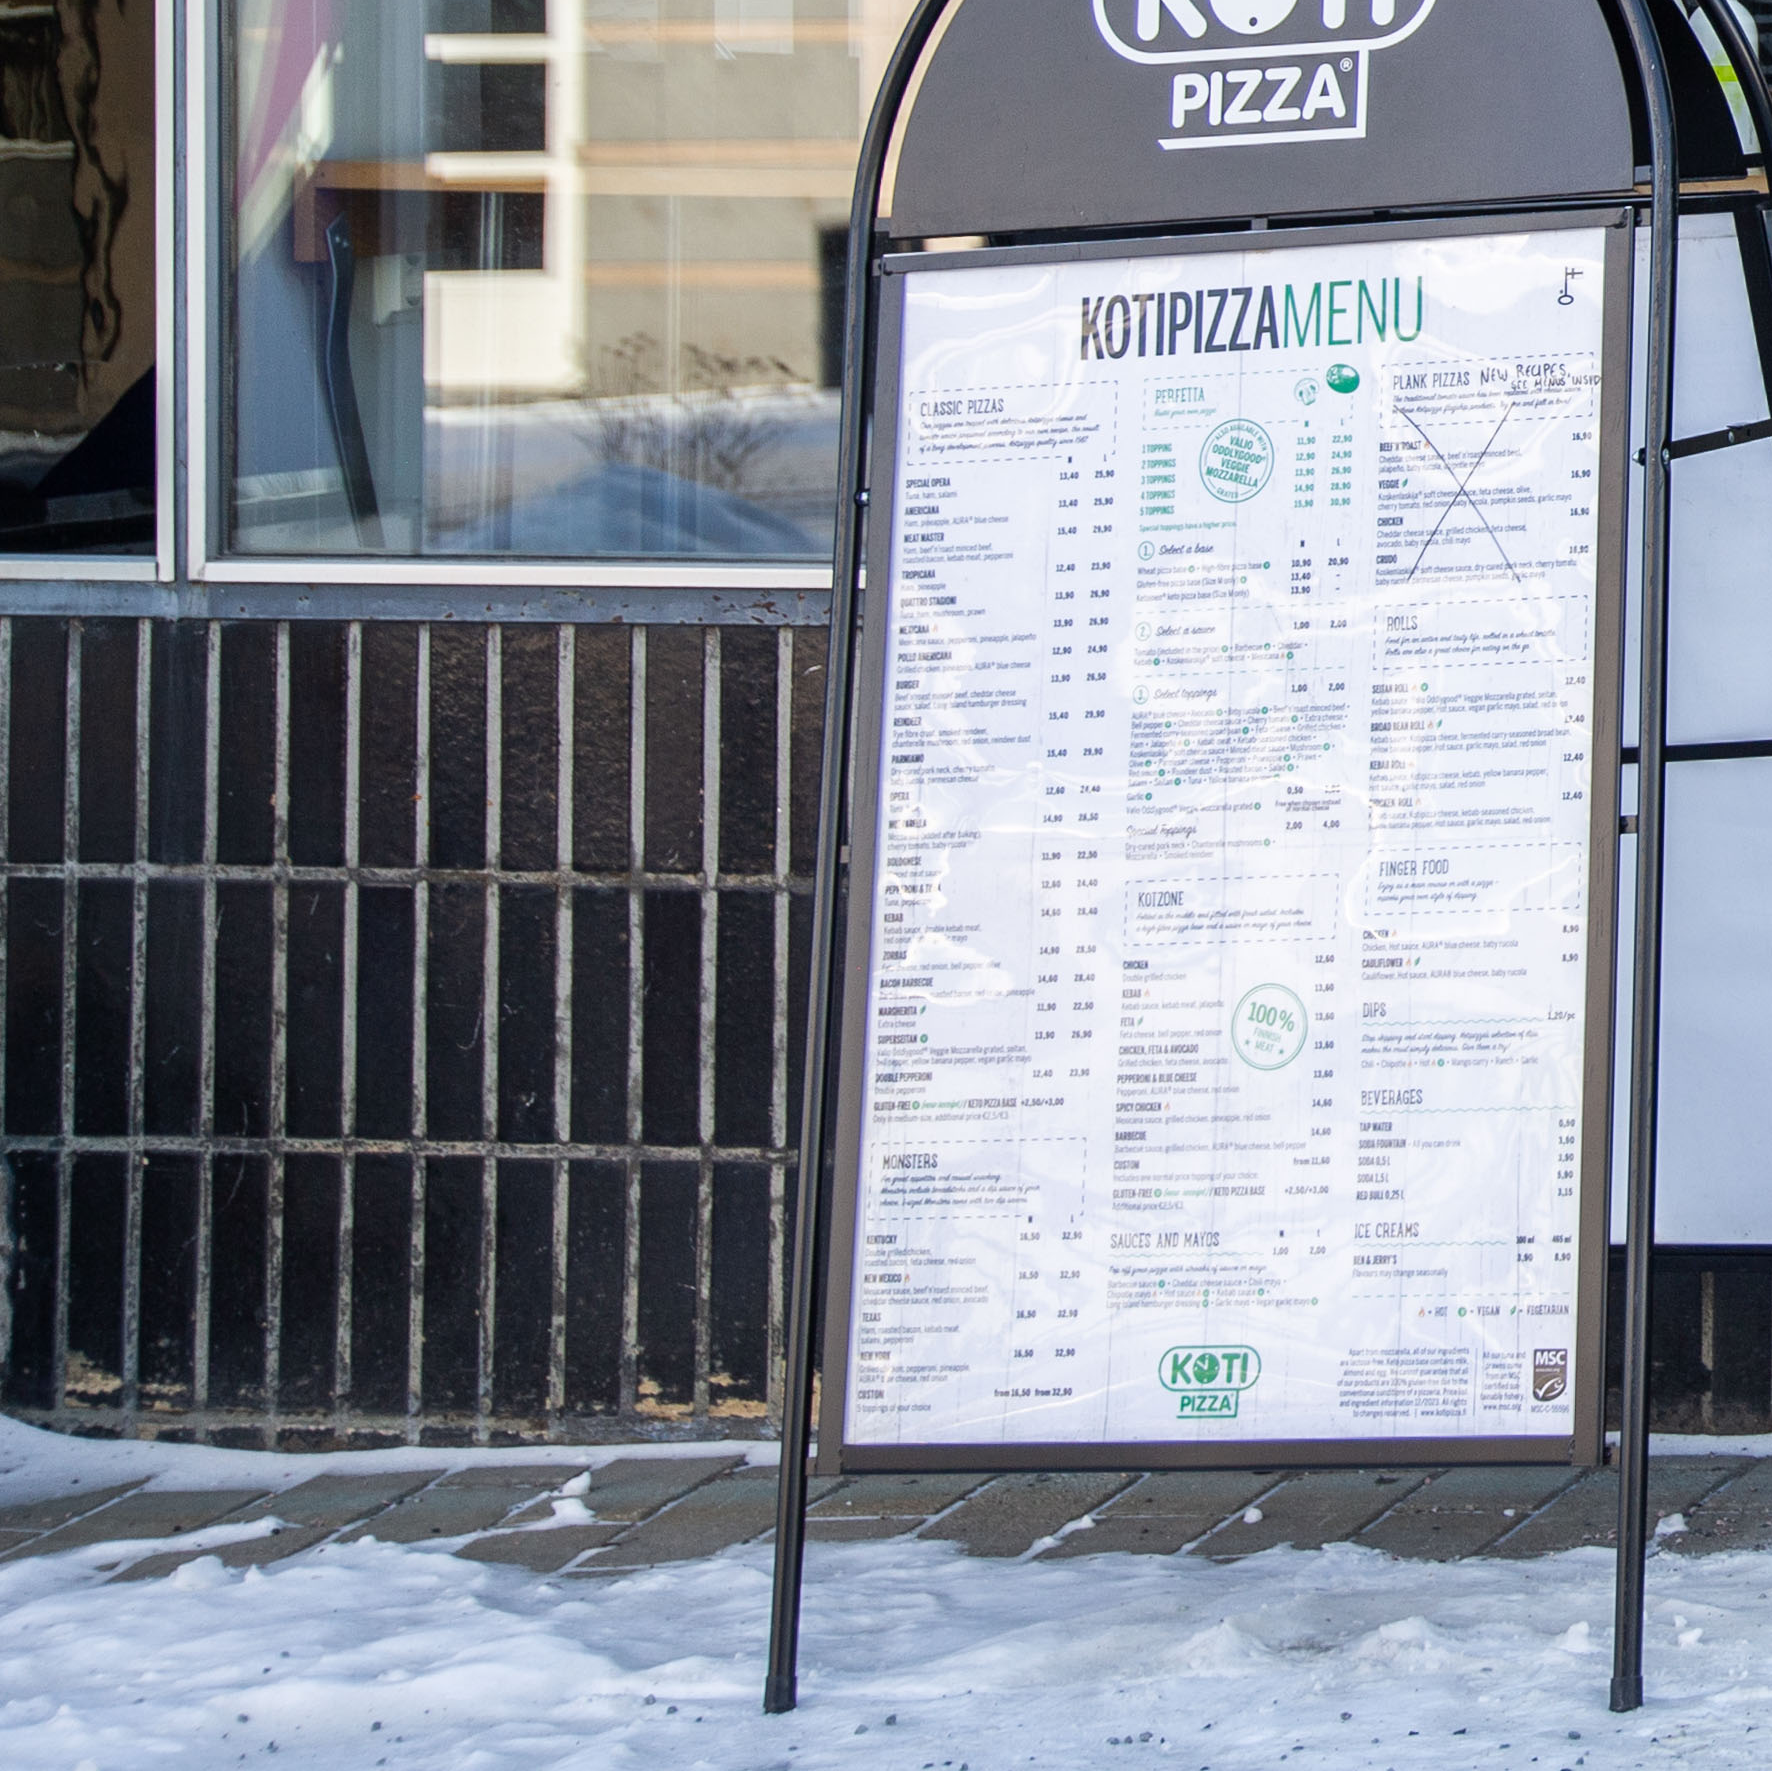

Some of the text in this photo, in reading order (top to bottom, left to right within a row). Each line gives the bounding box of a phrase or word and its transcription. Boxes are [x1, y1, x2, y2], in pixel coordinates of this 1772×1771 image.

[1392, 371, 1470, 391] PLANK PIZZAS
[1480, 366, 1509, 386] NEW
[1511, 379, 1528, 391] SEE
[1154, 386, 1206, 404] PERFETTA
[920, 398, 1005, 417] CLASSIC PIZZAS
[1230, 435, 1254, 450] VALIO
[1296, 436, 1316, 446] 11,90
[1146, 443, 1173, 454] TOPPING
[1295, 452, 1316, 462] 12,90
[1146, 459, 1177, 470] TOPPINGS
[1221, 457, 1251, 474] VEGGIE
[1059, 469, 1115, 481] 13,40 25,90
[1205, 465, 1259, 488] MOZZARELLA
[1294, 467, 1315, 477] 13,90
[905, 477, 951, 489] SPECIAL OPERA
[1146, 474, 1176, 485] TOPPINGS
[1377, 479, 1400, 490] VEGGIE
[1294, 483, 1315, 493] 14,90
[1145, 490, 1176, 501] TOPPINGS
[1058, 497, 1114, 509] 13,40 25,90
[1294, 499, 1314, 509] 15,90
[904, 505, 940, 516] AMERICANA
[1145, 506, 1175, 517] TOPPINGS
[1377, 516, 1404, 527] CHICKEN
[1057, 526, 1077, 536] 15,40
[904, 532, 945, 543] MEAT MASTER
[1158, 542, 1215, 556] Select base
[1376, 554, 1398, 565] CRUDO
[1055, 561, 1111, 573] 12,40 23,90
[901, 569, 936, 580] TROPICANA
[1290, 571, 1311, 581] 13,40
[1054, 590, 1075, 600] 13,90
[928, 596, 957, 606] STAGIONI
[1053, 618, 1074, 628] 13,90
[1293, 621, 1310, 631] 1,00
[1386, 614, 1418, 631] ROLLS
[1155, 625, 1216, 637] Select sauce
[1052, 644, 1108, 656] 12,90 24,90
[1290, 682, 1346, 693] 1,00 2,00
[1153, 687, 1218, 702] Select toppings
[1048, 711, 1069, 721] 15,40
[1370, 720, 1425, 732] BROAD ROLL
[1047, 748, 1068, 758] 15,40
[1563, 752, 1585, 762] 12,40
[1561, 791, 1583, 801] 12,40
[1285, 819, 1341, 831] 2,00 4,00
[1041, 851, 1062, 861] 11,90
[1379, 858, 1449, 877] FINGER FOOD
[1137, 890, 1185, 908] KOTZONE
[884, 912, 904, 923] KEBAB
[1122, 960, 1149, 971] CHICKEN
[1361, 957, 1404, 969] CAULIFLOWER
[879, 977, 934, 989] BACON BARBECUE
[1121, 988, 1142, 999] KEBAB
[1036, 1002, 1057, 1012] 11,90
[1362, 1001, 1387, 1018] DIPS
[1120, 1016, 1136, 1027] FETA
[1246, 1001, 1296, 1033] 100%
[1147, 1044, 1164, 1055] FETA
[1169, 1043, 1199, 1054] AVOCADO
[1254, 1041, 1275, 1054] MEAT
[875, 1073, 898, 1084] DOUBLE
[1032, 1068, 1053, 1078] 12,40
[1116, 1072, 1198, 1085] PEPPERONI BLUE CHEESE
[1361, 1088, 1424, 1106] BEVERAGES
[1115, 1101, 1162, 1113] SPICY CHICKEN
[1359, 1121, 1393, 1132] TAP WATER
[1114, 1130, 1147, 1141] BARBECUE
[1358, 1138, 1375, 1149] SODA
[882, 1152, 939, 1170] MONSTERS
[1113, 1160, 1140, 1170] CUSTOM
[1357, 1156, 1375, 1166] SODA
[1356, 1173, 1374, 1183] SODA
[1356, 1190, 1369, 1201] RED
[1354, 1222, 1420, 1239] ICE CREAMS
[866, 1234, 898, 1245] KENTUCKY
[1110, 1231, 1220, 1250] SAUCES AND MAYOS
[1371, 1254, 1398, 1265] JERRY'S
[863, 1273, 878, 1284] NEW
[1434, 1304, 1570, 1317] HOT VEGAN VEGETARIAN
[1535, 1350, 1566, 1366] MSC
[1170, 1352, 1250, 1385] KOTI
